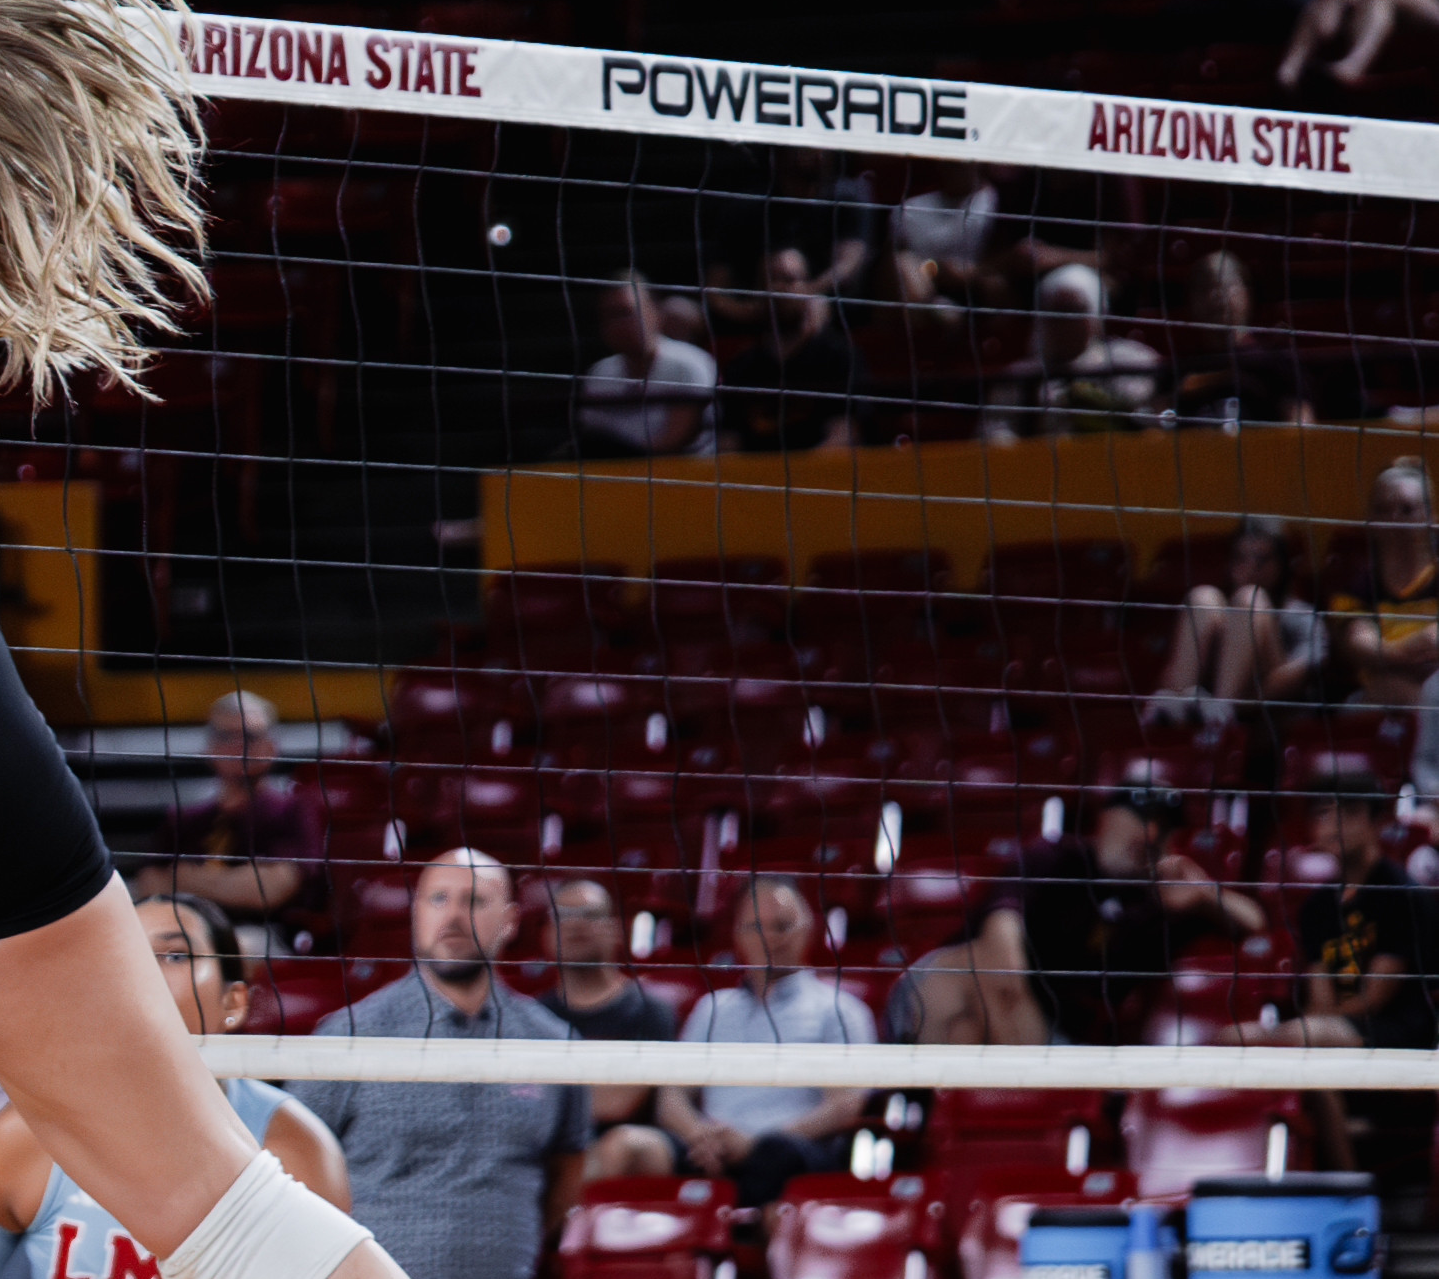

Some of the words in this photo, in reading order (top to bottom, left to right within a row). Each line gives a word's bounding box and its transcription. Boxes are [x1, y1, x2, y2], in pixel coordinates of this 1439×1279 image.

[365, 35, 482, 98] STATE
[602, 56, 967, 140] POWERADE
[1087, 102, 1239, 164] ARIZONA
[1251, 117, 1352, 173] STATE
